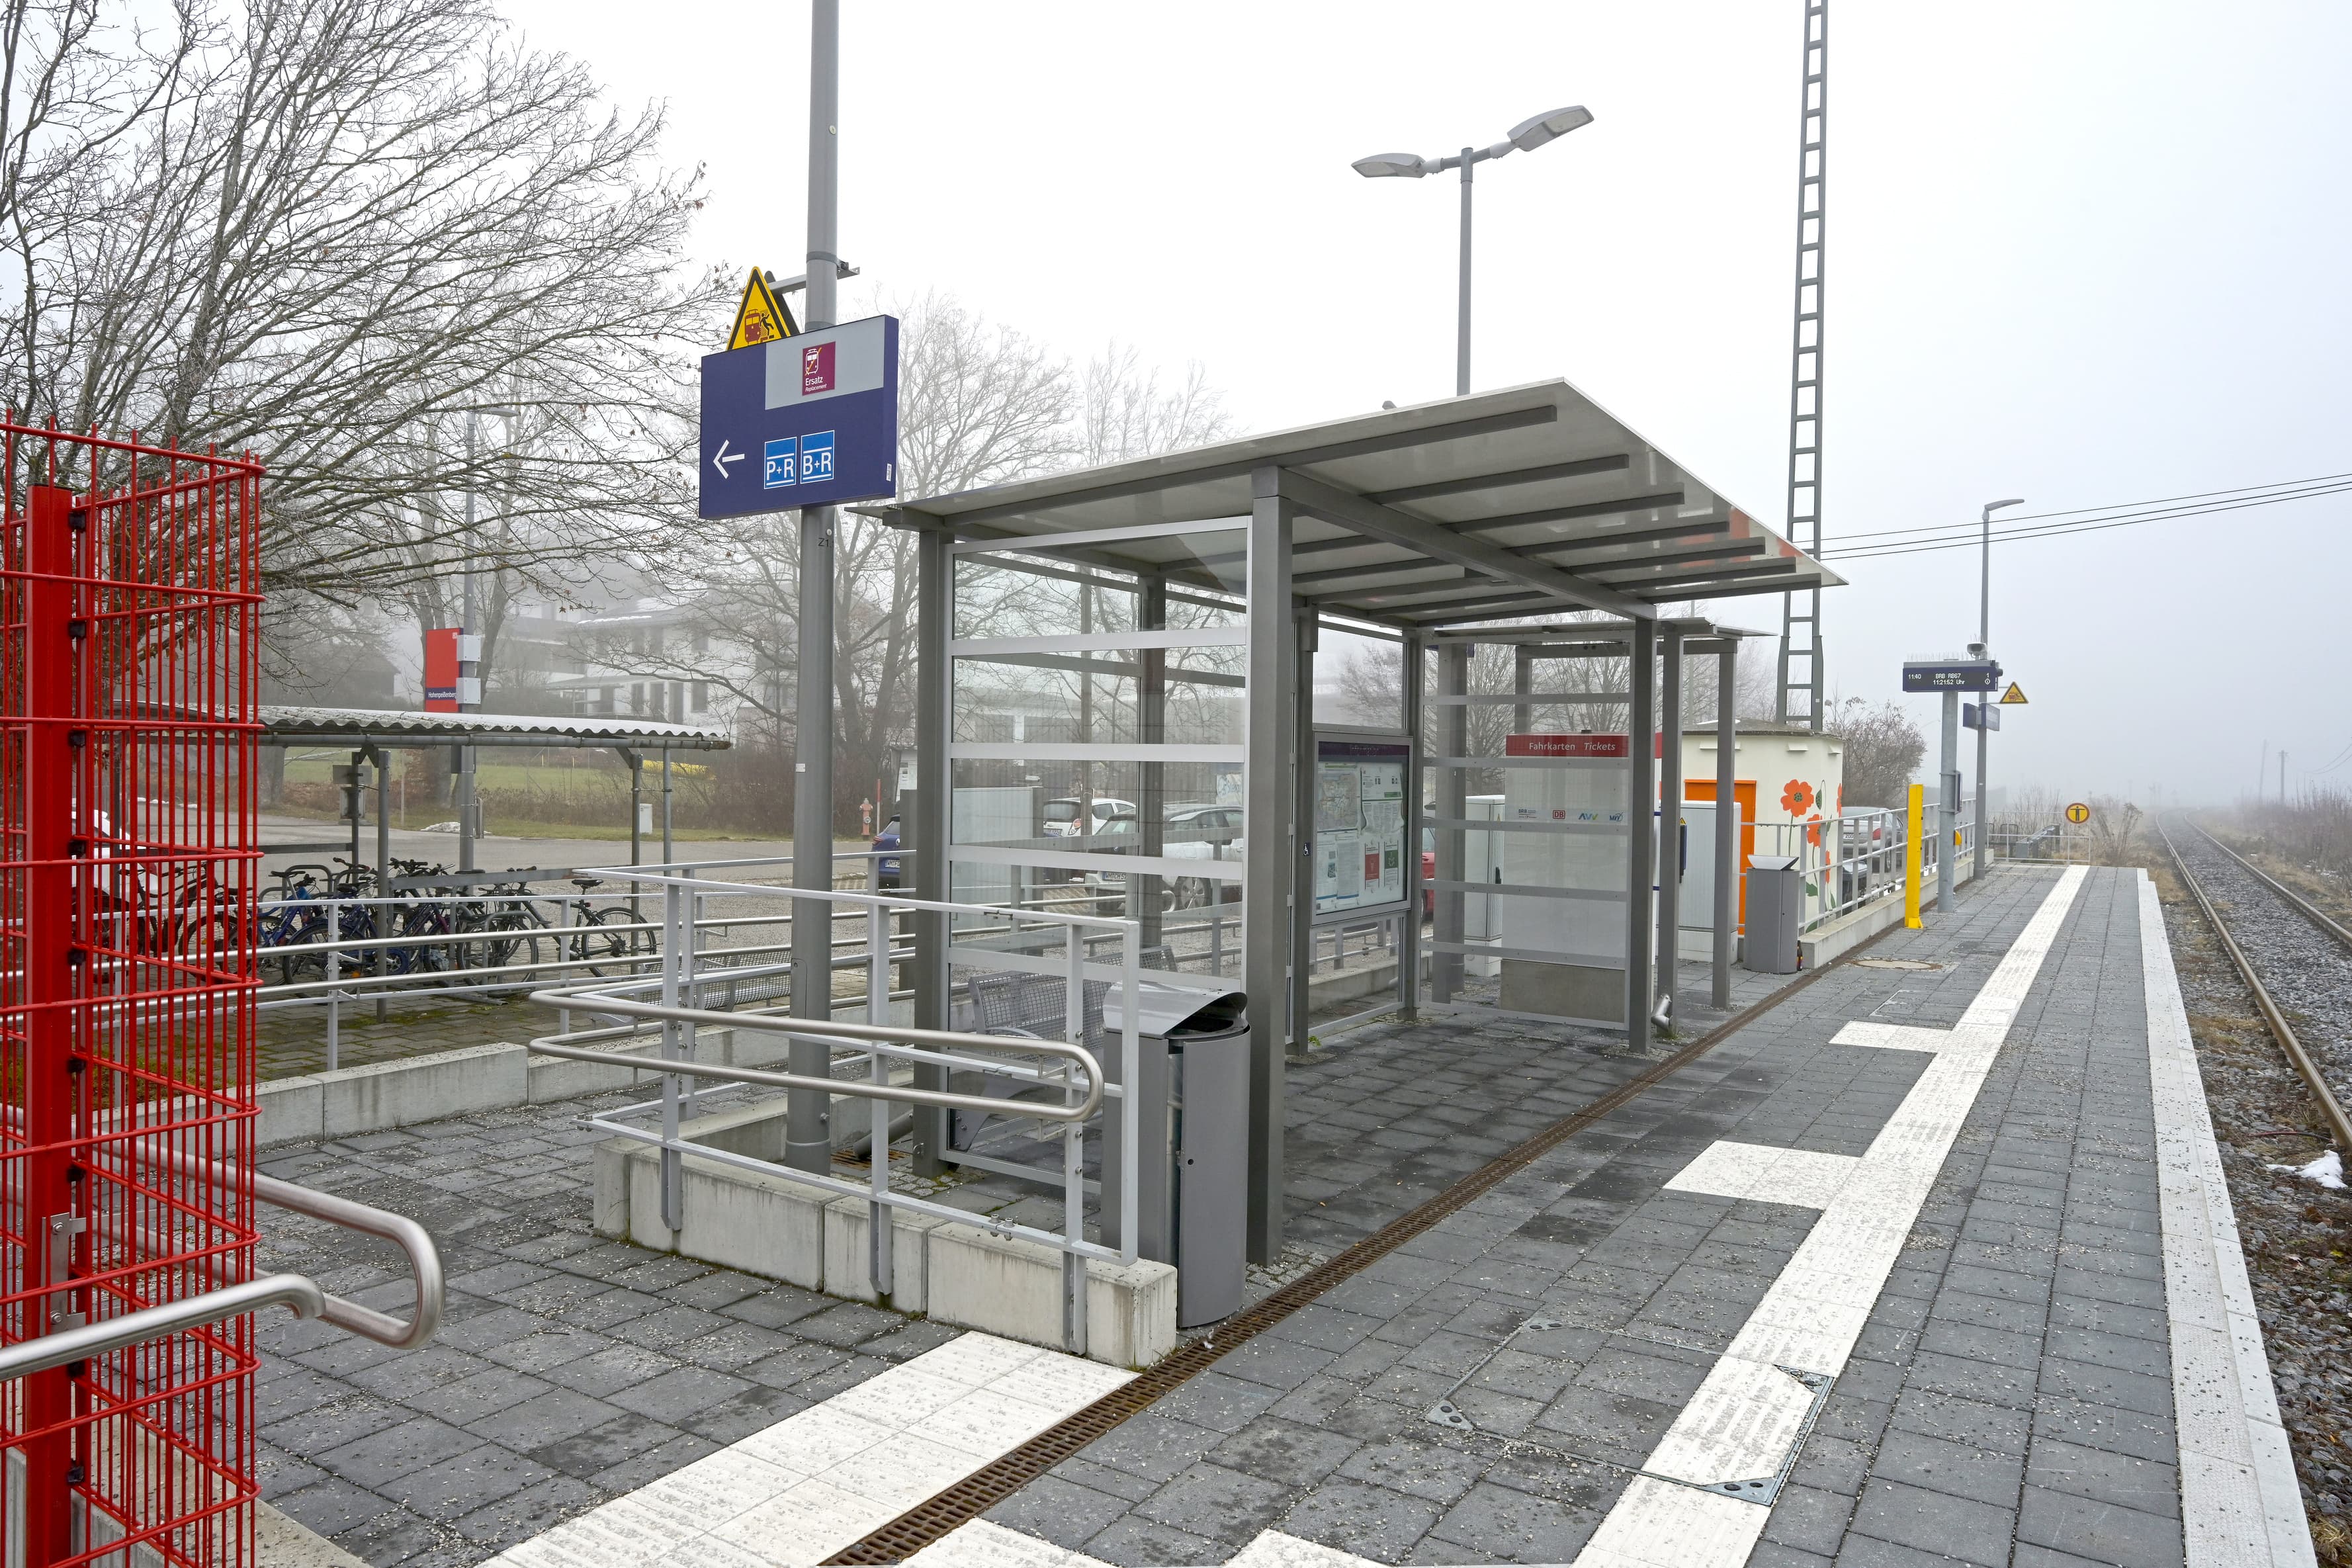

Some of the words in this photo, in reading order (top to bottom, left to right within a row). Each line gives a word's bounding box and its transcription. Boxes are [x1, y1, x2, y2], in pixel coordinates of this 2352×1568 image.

[805, 376, 823, 386] Ersatz
[766, 458, 794, 480] P+R
[803, 452, 832, 475] B+R
[1584, 742, 1616, 751] Tickets
